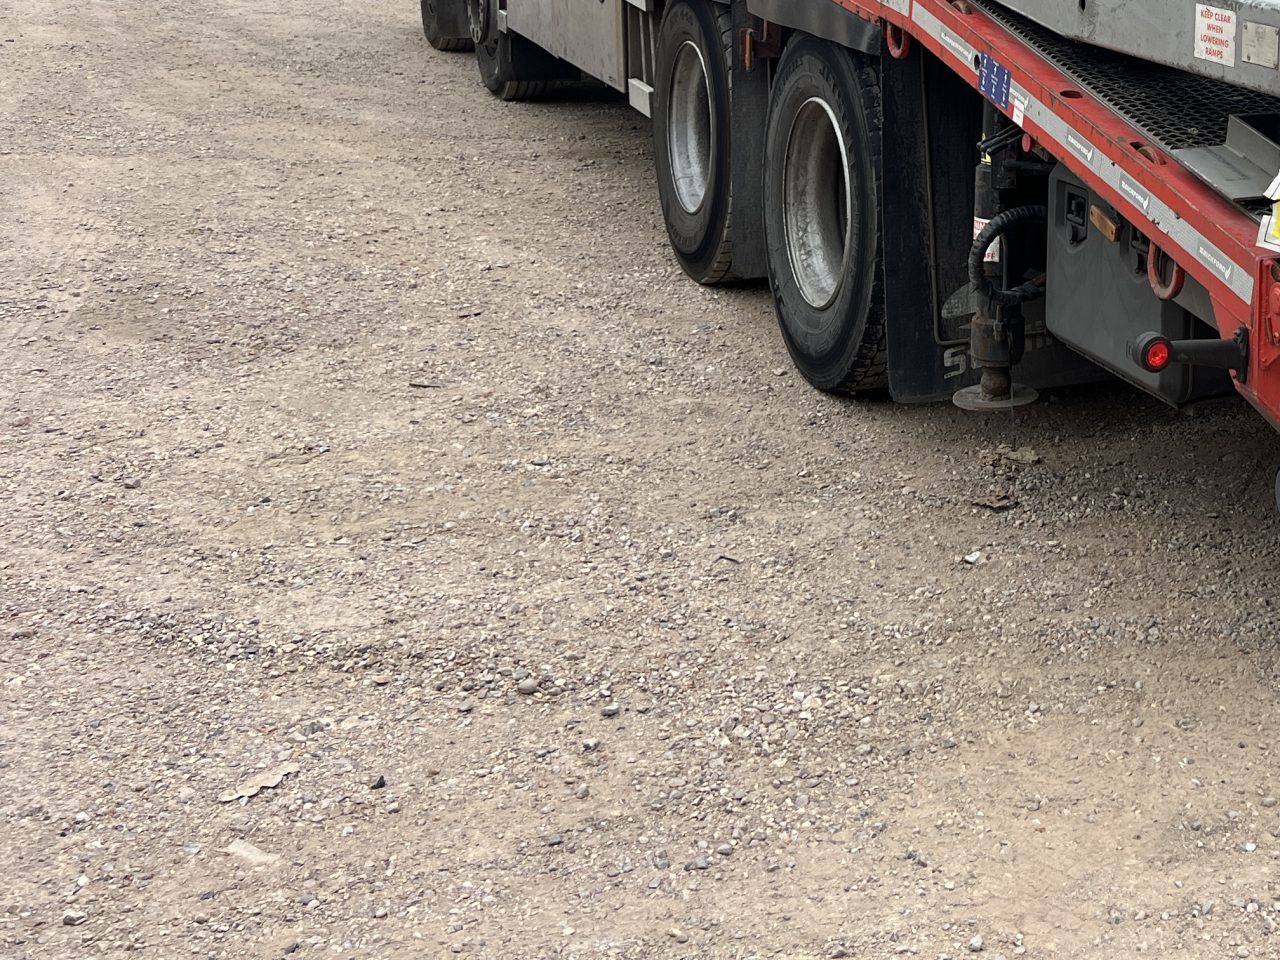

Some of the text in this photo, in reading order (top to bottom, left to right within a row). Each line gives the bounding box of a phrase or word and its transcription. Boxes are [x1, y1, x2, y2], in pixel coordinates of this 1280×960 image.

[1201, 8, 1231, 23] KEEP CLEAR
[1206, 23, 1223, 34] WHEN
[1200, 34, 1229, 49] LOWERING
[1205, 46, 1224, 59] RAMPS
